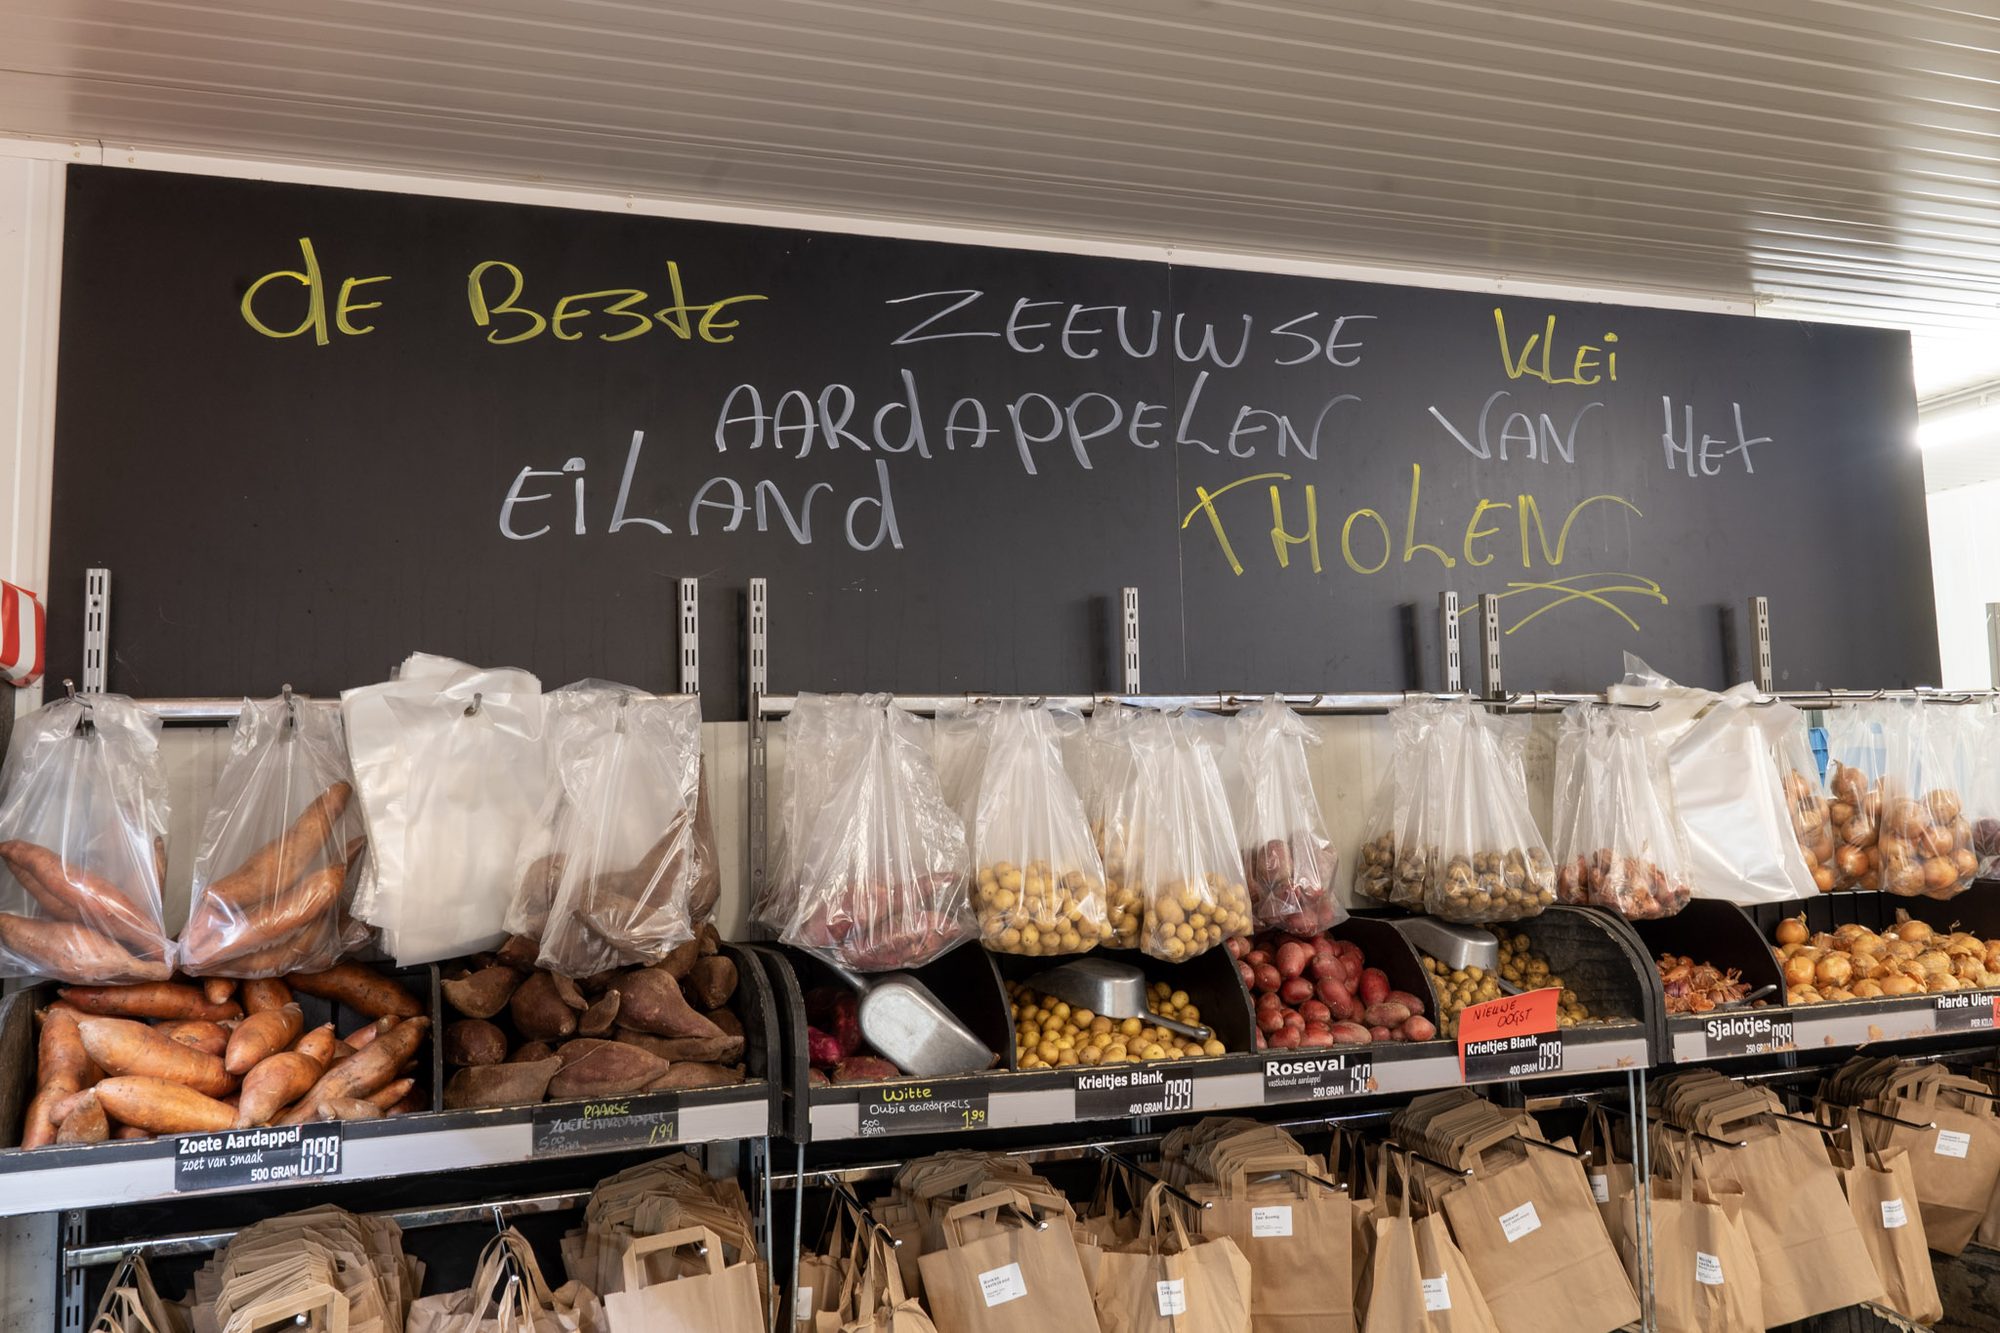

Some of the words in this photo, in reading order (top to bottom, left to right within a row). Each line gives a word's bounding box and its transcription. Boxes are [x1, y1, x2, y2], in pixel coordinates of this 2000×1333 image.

[1427, 391, 1605, 463] VAN
[1181, 463, 1642, 576] THOLEN
[1937, 995, 1968, 1008] Harde
[1971, 992, 1994, 1006] Uien
[1707, 1016, 1771, 1041] Sjalotjes
[1467, 1041, 1508, 1055] Krieltjes
[1511, 1036, 1538, 1049] Blank
[1539, 1041, 1562, 1071] 099
[1266, 1055, 1345, 1077] Roseval
[1509, 1065, 1520, 1076] 400
[1521, 1062, 1538, 1073] GRAM
[1078, 1074, 1128, 1091] Krieltjes
[1131, 1070, 1164, 1086] Blank
[1313, 1086, 1325, 1098] 500
[1326, 1085, 1344, 1097] GRAM
[1164, 1079, 1192, 1111] 099
[1129, 1103, 1142, 1115] 400
[1143, 1101, 1163, 1114] GRAM
[179, 1137, 222, 1154] Zoete
[225, 1127, 300, 1150] Aardappel
[182, 1159, 204, 1172] zoet
[208, 1157, 227, 1168] van
[230, 1149, 263, 1166] smaak
[300, 1135, 339, 1176] 099
[251, 1168, 269, 1181] 500
[271, 1164, 298, 1179] GRAM
